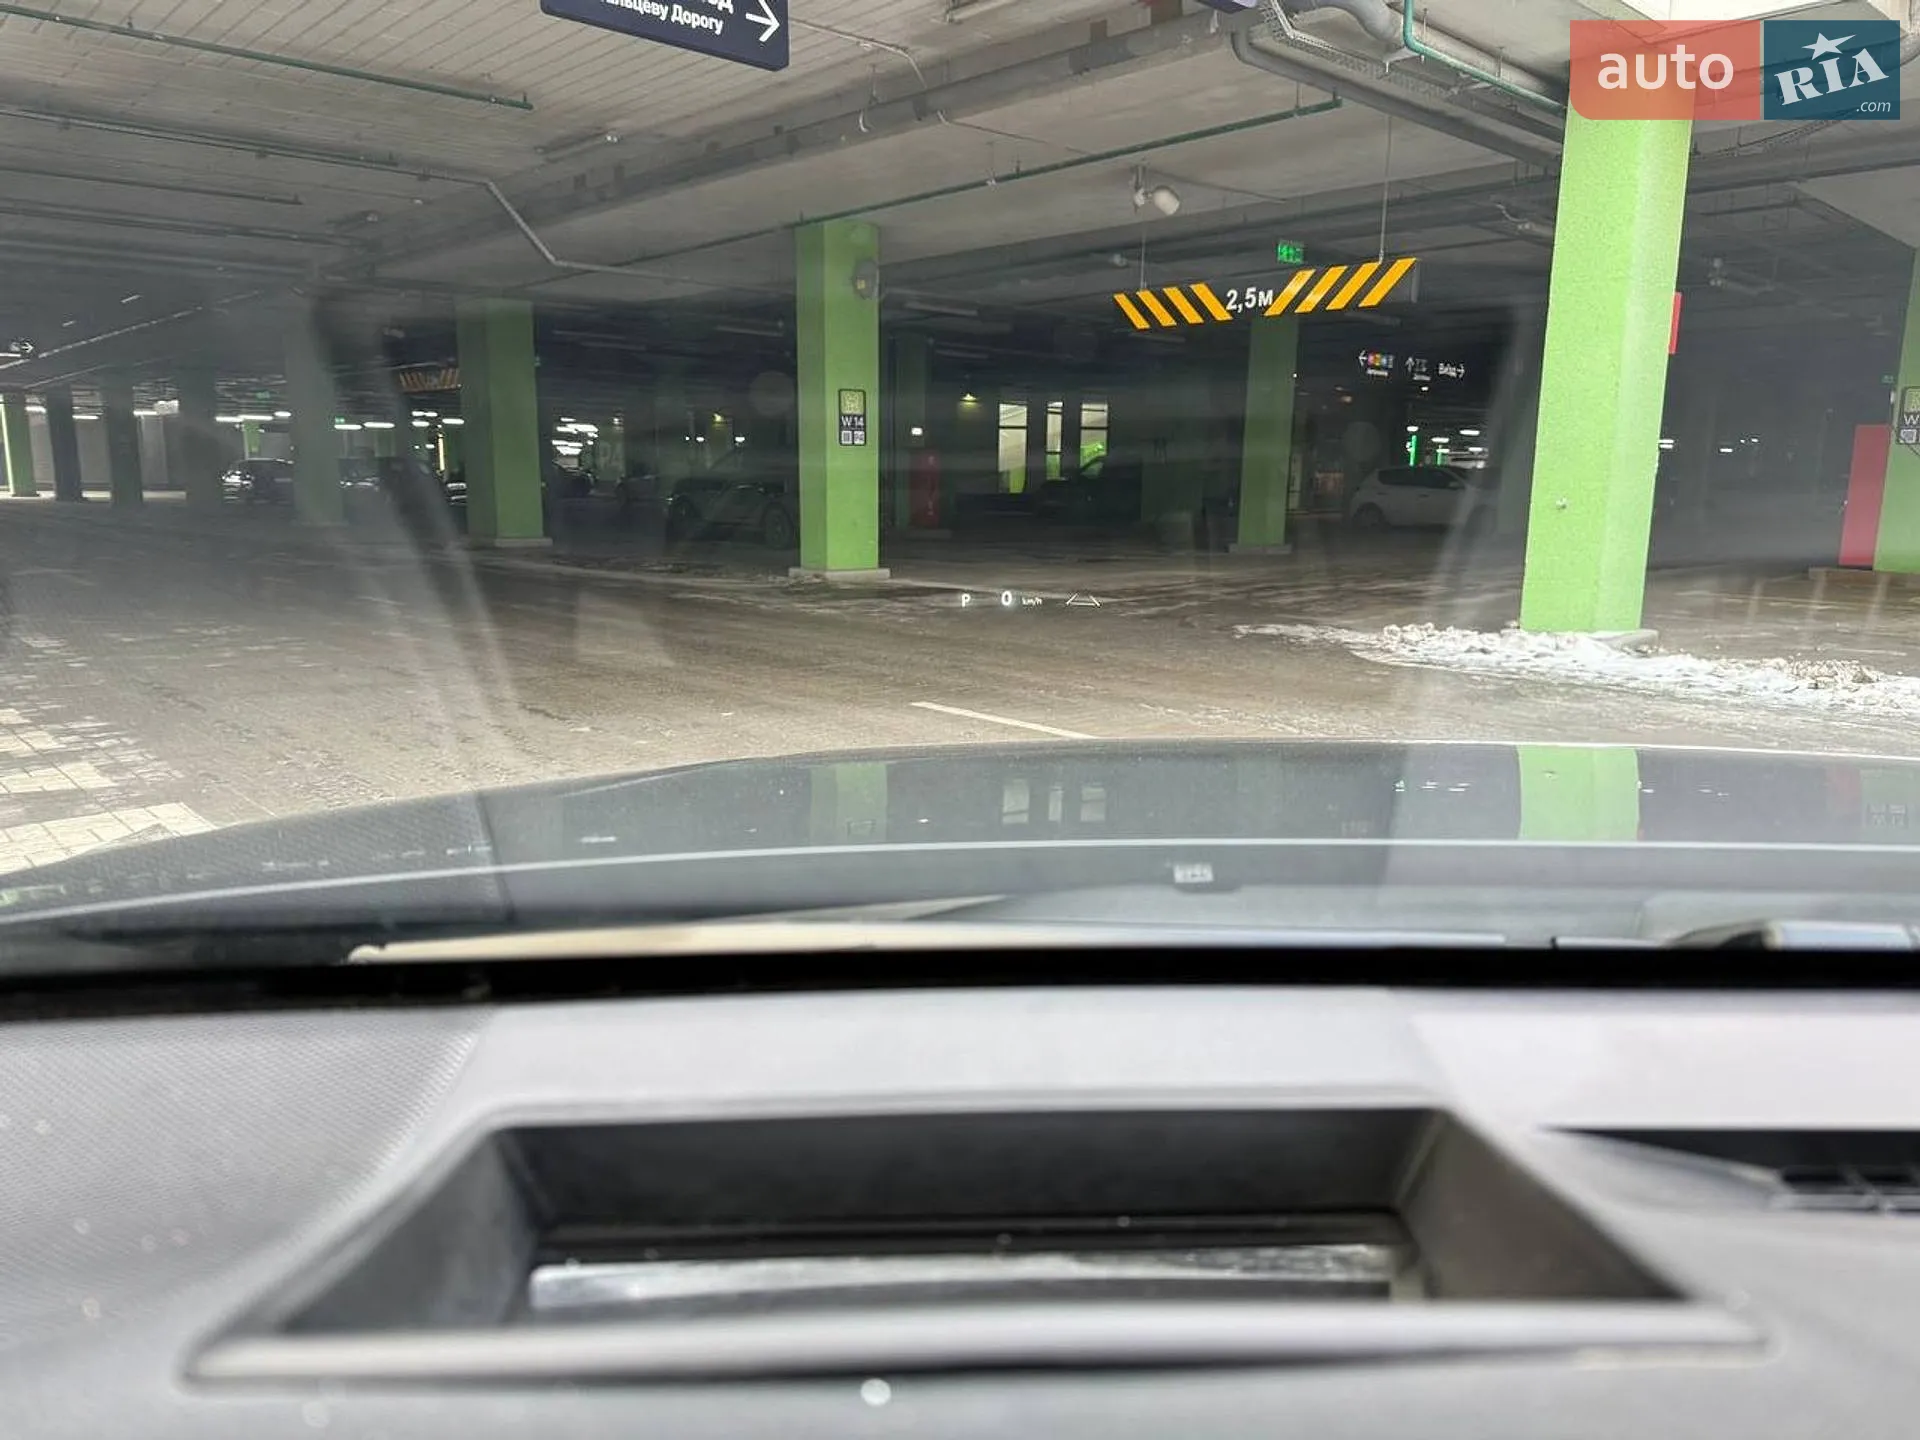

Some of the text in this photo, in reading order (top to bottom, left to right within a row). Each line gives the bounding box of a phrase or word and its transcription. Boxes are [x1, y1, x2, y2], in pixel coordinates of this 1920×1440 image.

[671, 3, 724, 35] Дорогу
[961, 594, 971, 607] P
[1001, 590, 1012, 606] 0
